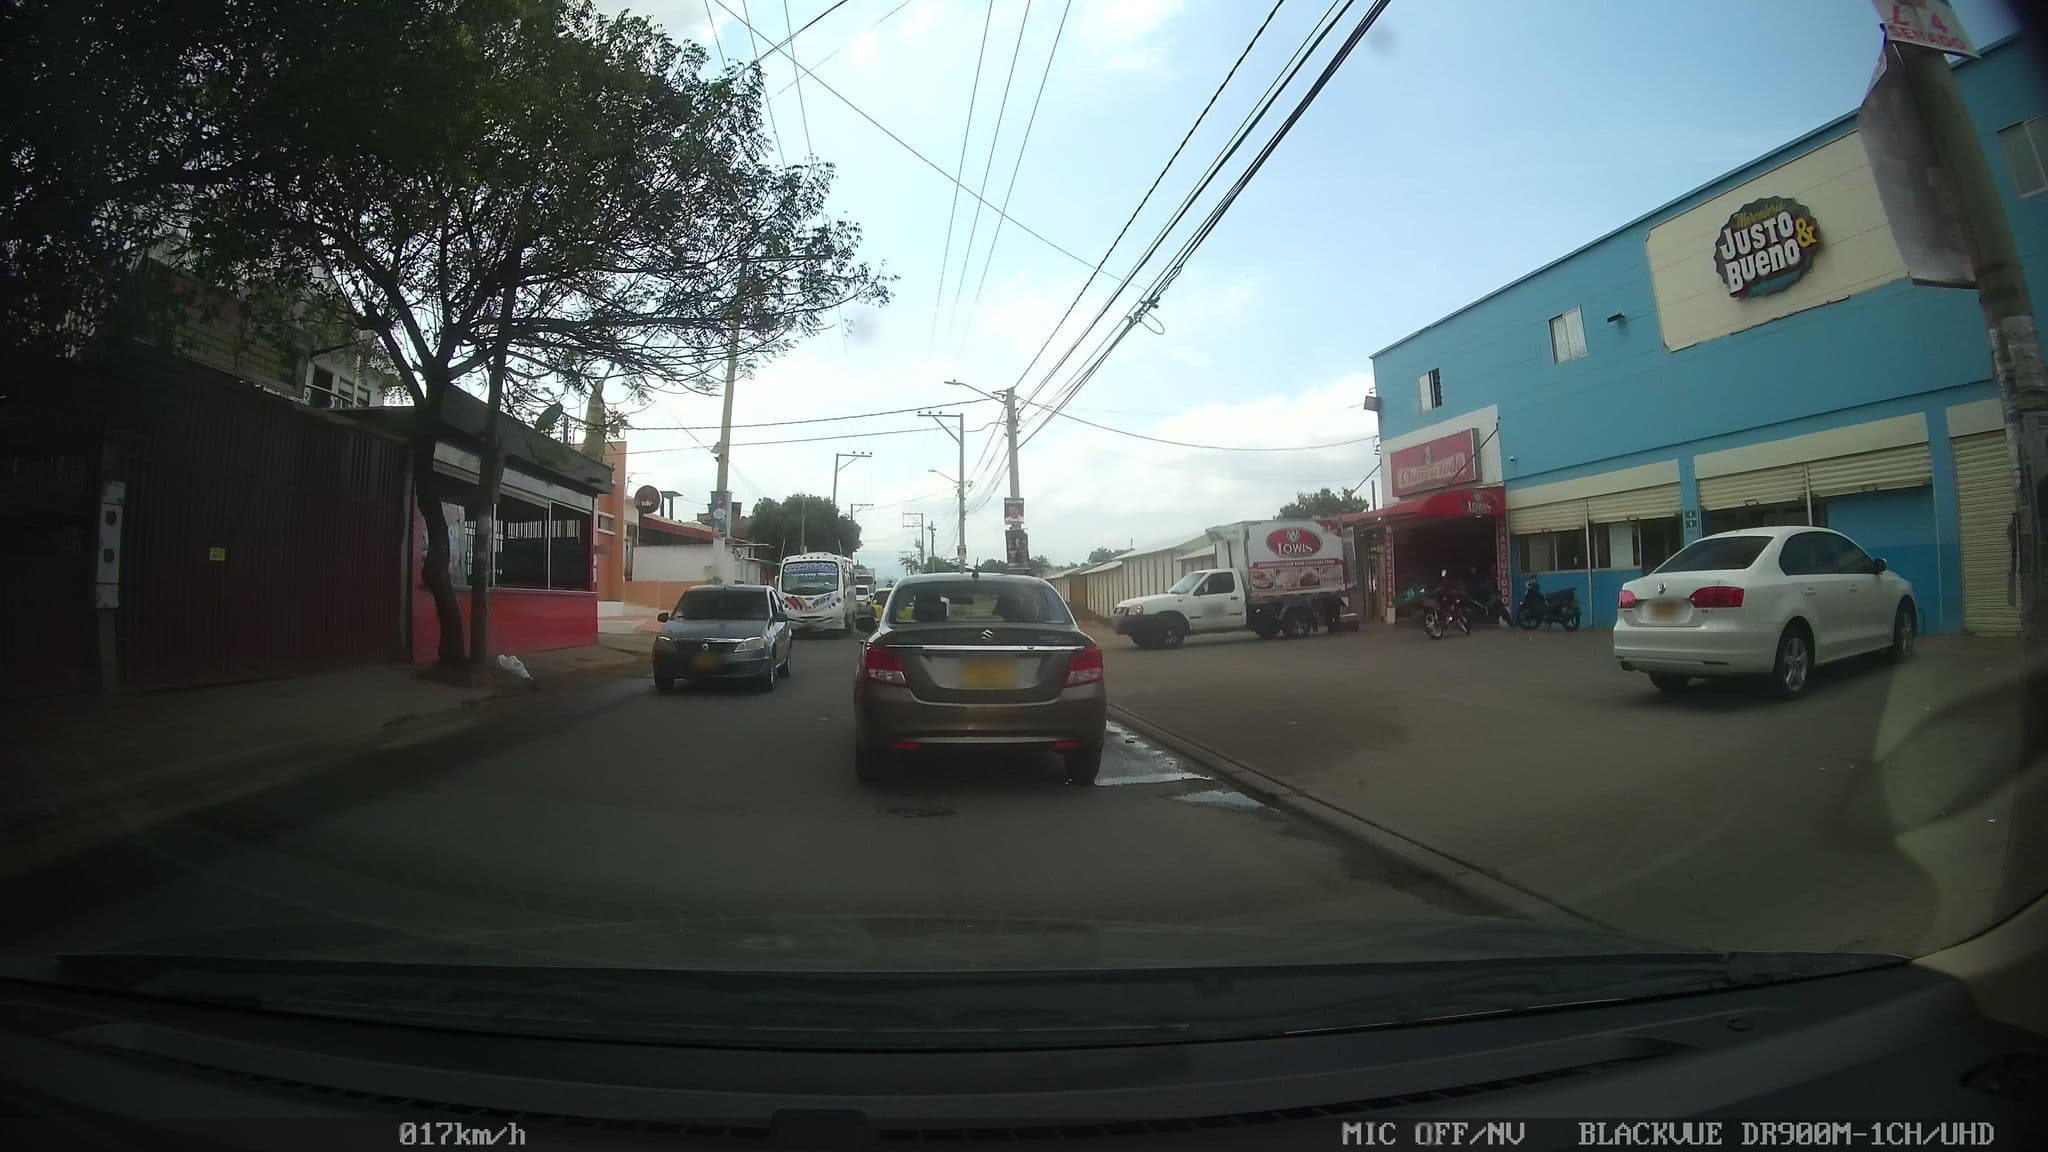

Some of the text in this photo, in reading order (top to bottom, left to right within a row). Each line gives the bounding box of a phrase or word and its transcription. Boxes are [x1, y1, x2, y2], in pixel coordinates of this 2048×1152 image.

[1887, 24, 1970, 50] SENADO
[1720, 211, 1817, 260] JUSTO &
